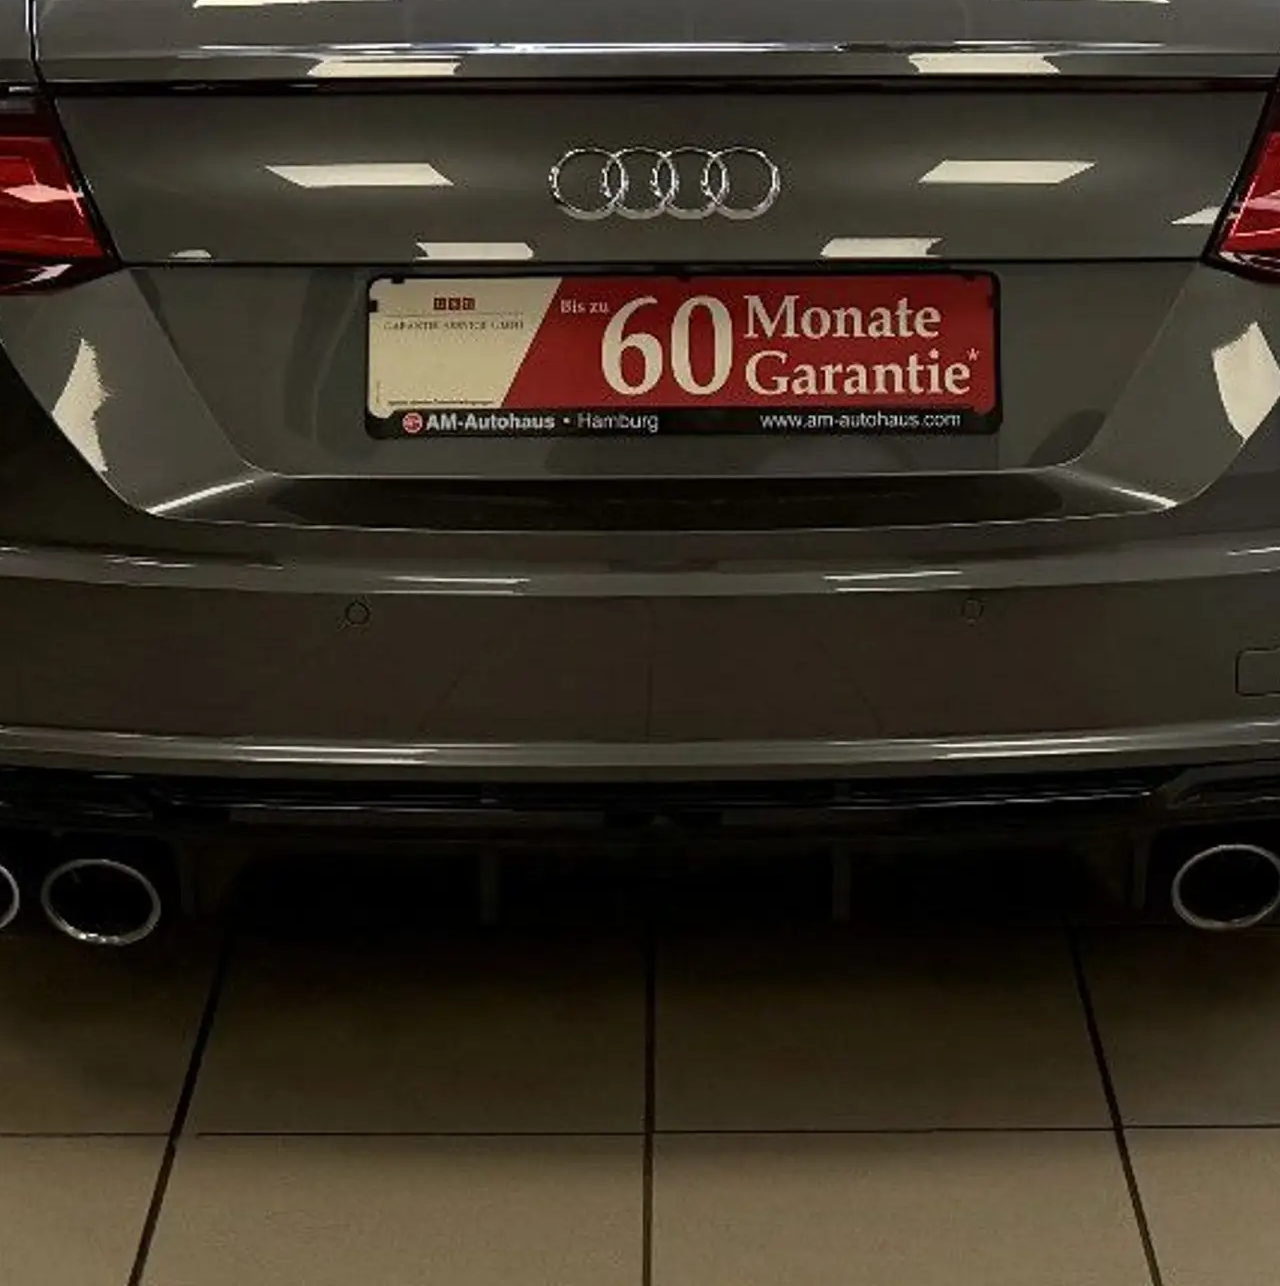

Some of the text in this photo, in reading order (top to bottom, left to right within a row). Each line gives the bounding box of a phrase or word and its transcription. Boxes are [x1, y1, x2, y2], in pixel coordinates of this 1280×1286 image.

[559, 294, 942, 396] Bis zu 60 Monate
[425, 413, 557, 432] AM-Autohaus
[577, 413, 660, 434] Hamburg
[759, 411, 962, 430] www.am-autohaus.com
